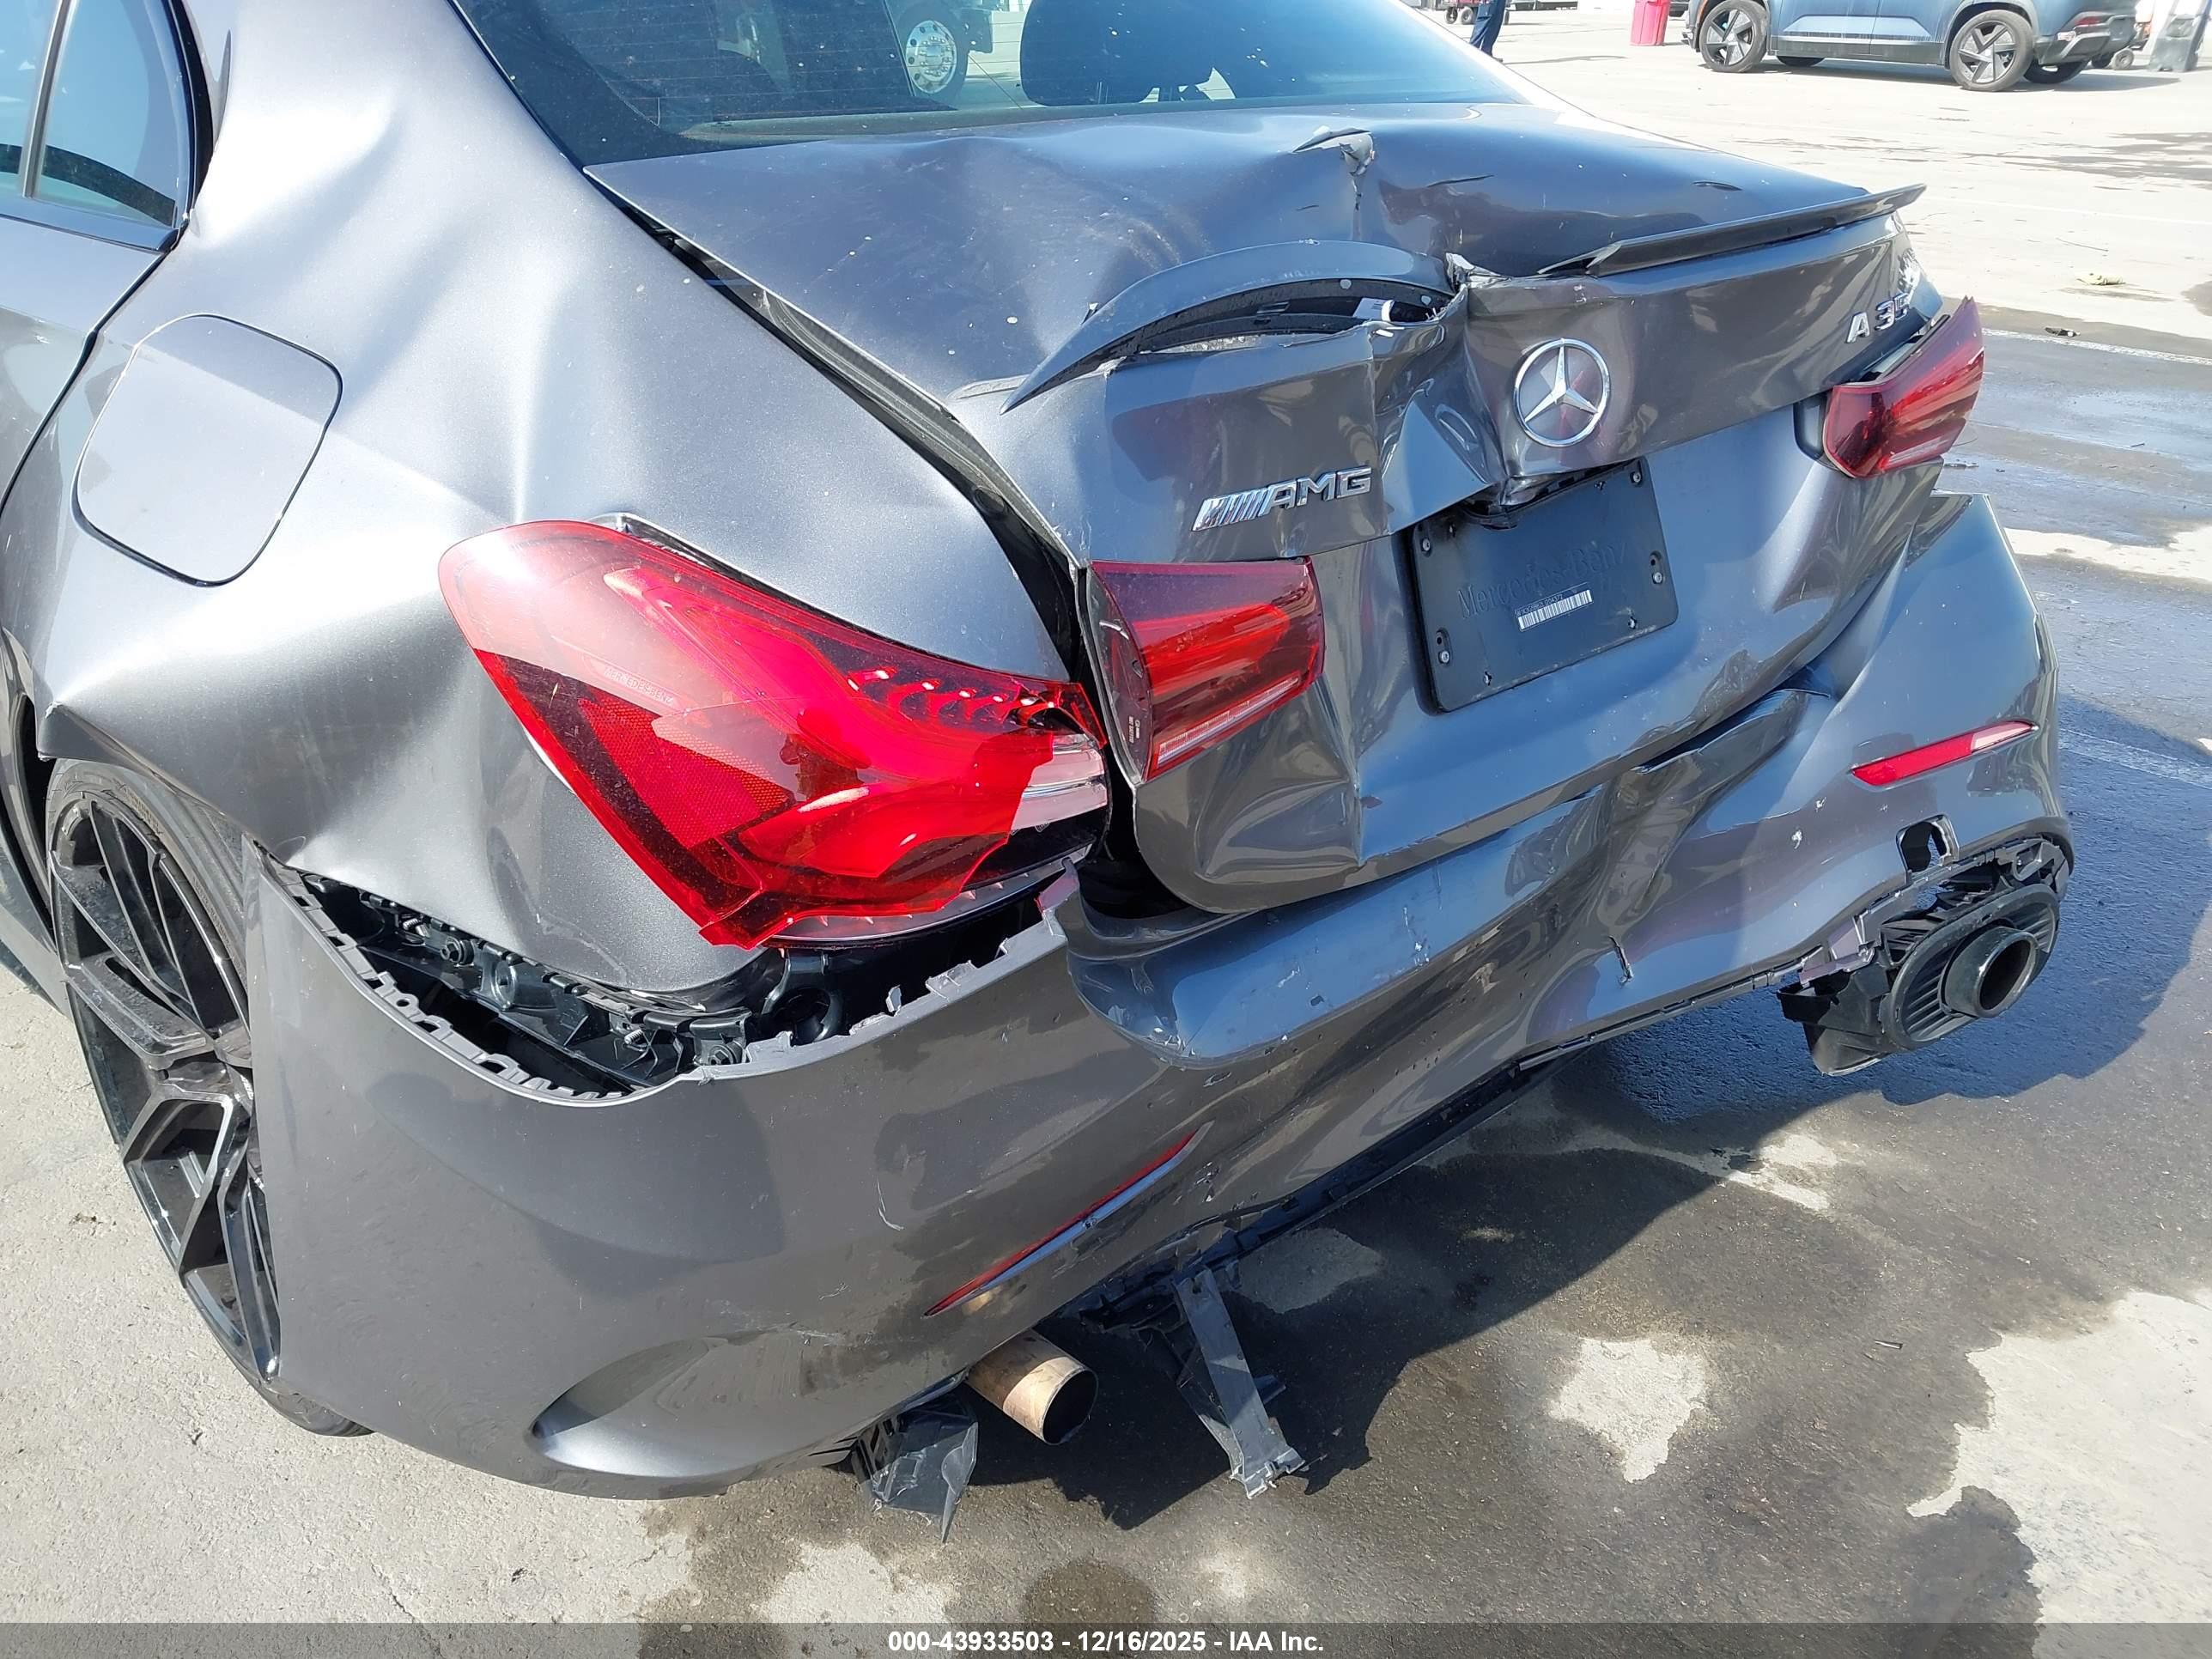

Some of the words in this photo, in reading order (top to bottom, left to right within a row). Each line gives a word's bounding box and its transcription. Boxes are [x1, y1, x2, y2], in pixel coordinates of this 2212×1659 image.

[1844, 311, 1871, 343] A
[1875, 293, 1910, 331] 35
[1257, 465, 1372, 517] AMG
